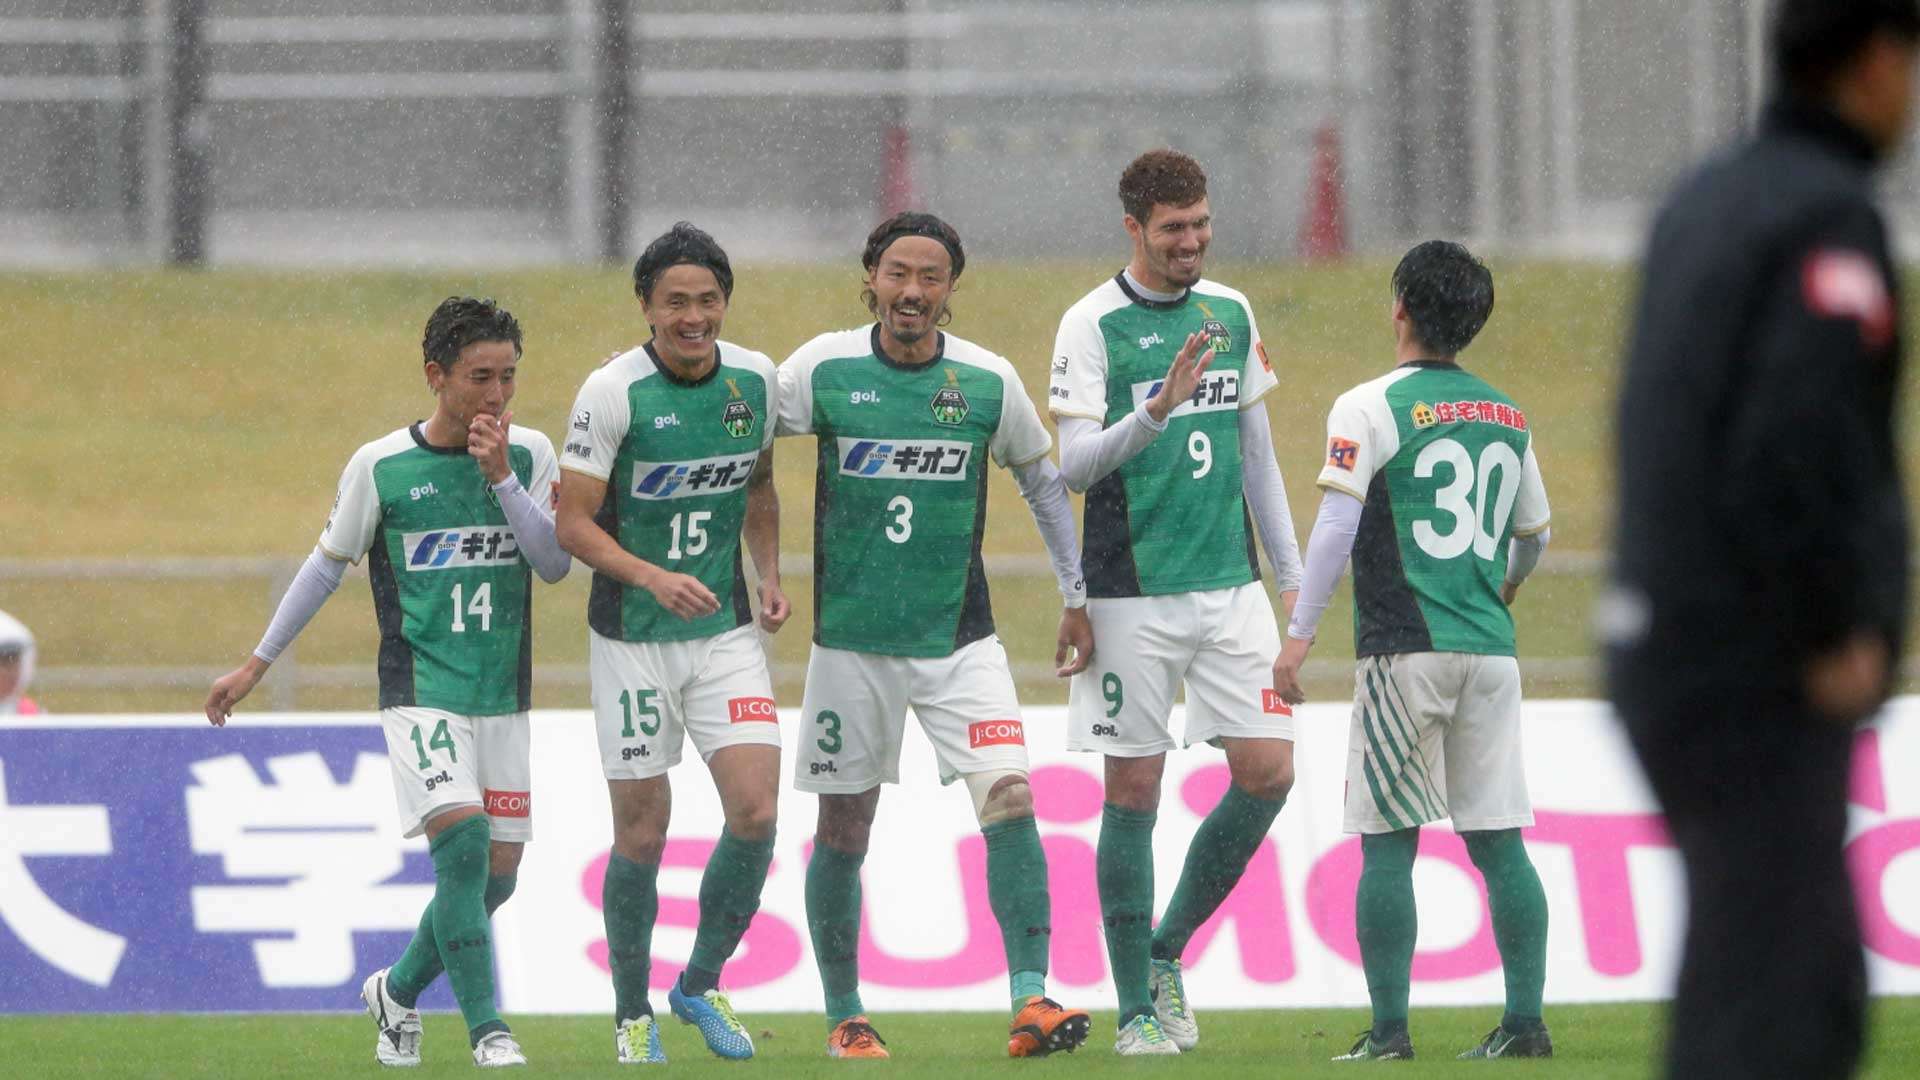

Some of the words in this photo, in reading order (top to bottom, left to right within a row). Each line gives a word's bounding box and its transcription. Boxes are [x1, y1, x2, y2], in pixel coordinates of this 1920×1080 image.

[1139, 332, 1164, 350] gol.
[850, 390, 880, 405] gol.
[654, 413, 680, 430] gol.
[893, 446, 967, 475] ギオン
[1188, 430, 1213, 480] 9
[687, 459, 755, 491] ギオン
[409, 482, 438, 500] gol.
[1412, 438, 1521, 561] 30
[885, 495, 913, 544] 3
[461, 532, 519, 560] ギオン
[667, 511, 712, 560] 15
[450, 582, 493, 632] 14
[1102, 672, 1123, 718] 9
[619, 689, 661, 738] 15
[410, 719, 457, 770] 14
[816, 709, 842, 754] 3
[974, 724, 1022, 744] J:COM
[1091, 724, 1118, 737] gol.
[622, 744, 650, 760] gol.
[425, 770, 453, 791] gol.
[810, 760, 837, 775] gol.
